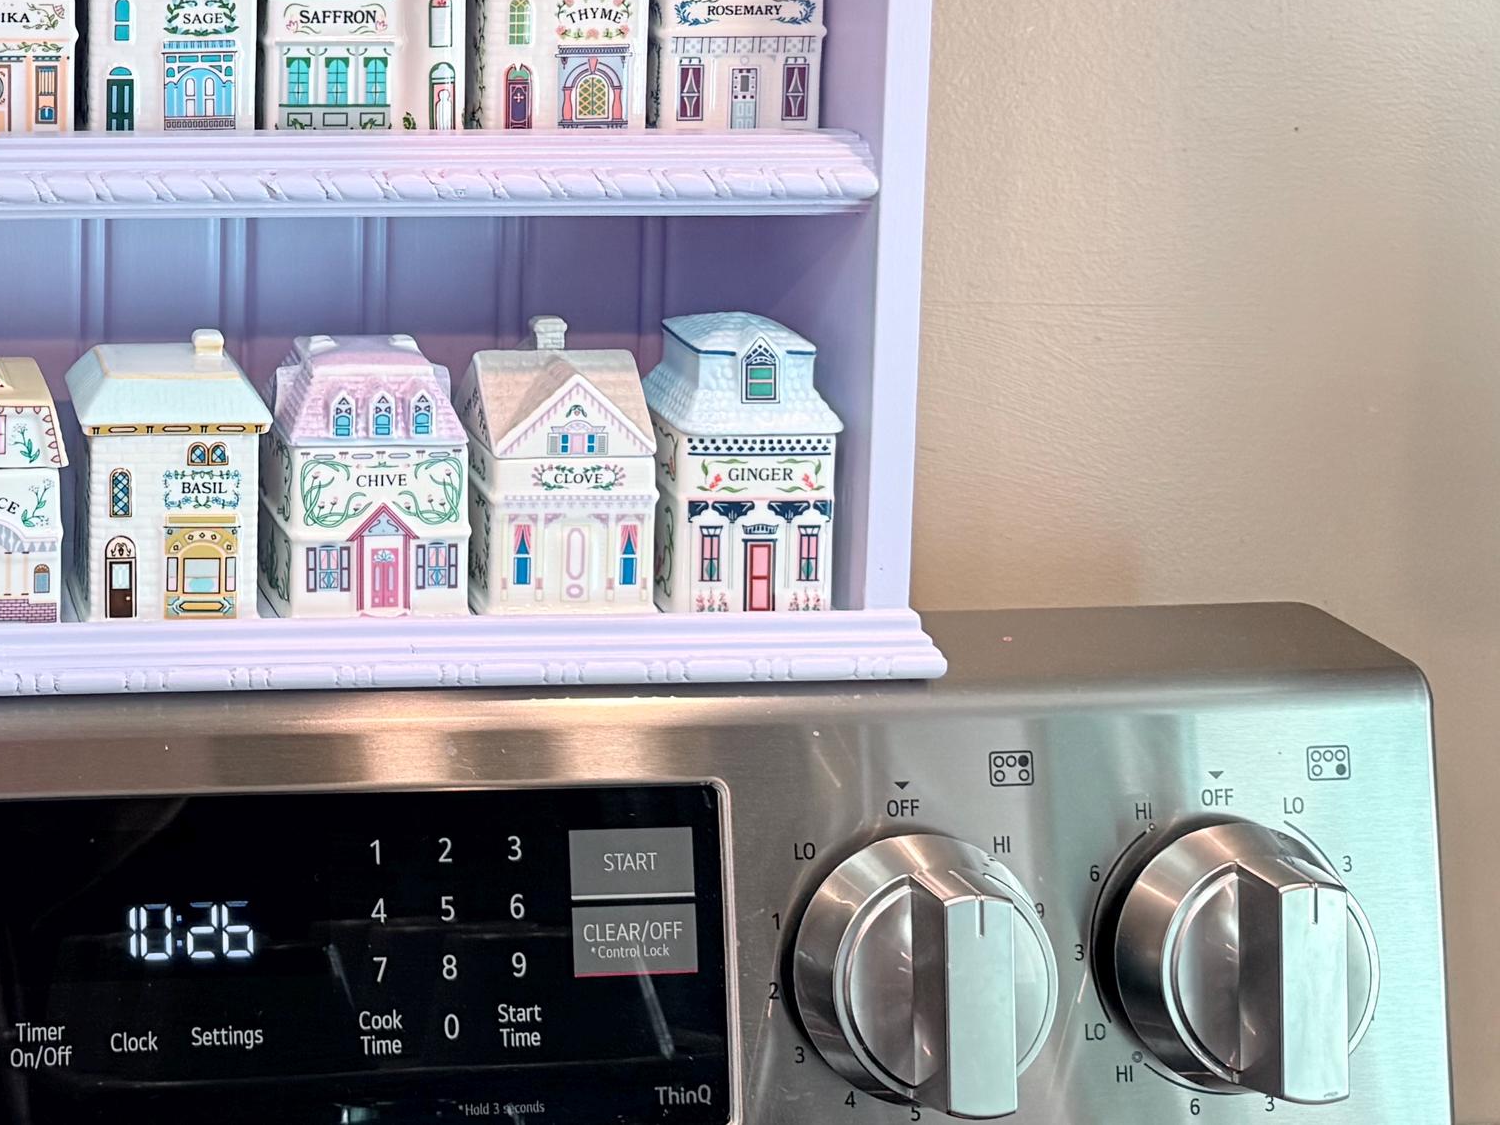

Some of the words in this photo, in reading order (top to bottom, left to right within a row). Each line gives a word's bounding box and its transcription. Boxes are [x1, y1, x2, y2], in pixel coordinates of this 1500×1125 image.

[182, 10, 224, 27] SAGE
[298, 6, 377, 27] SAFFRON
[565, 6, 623, 27] THYME
[706, 2, 782, 18] ROSEMARY
[356, 472, 408, 489] CHIVE
[553, 470, 604, 486] CLOVE
[727, 466, 794, 484] GINGER
[180, 480, 228, 496] BASIL
[1202, 789, 1233, 806] OFF
[1284, 797, 1304, 814] LO
[887, 799, 919, 817] OFF
[1136, 803, 1152, 820] HI
[370, 840, 380, 864] 1
[439, 838, 452, 862] 2
[508, 836, 521, 860] 3
[794, 843, 815, 860] LO
[994, 836, 1010, 853] HI
[604, 853, 657, 871] START
[1343, 856, 1352, 872] 3
[1090, 865, 1099, 882] 6
[371, 898, 387, 923] 4
[442, 896, 454, 921] 5
[511, 894, 524, 919] 6
[1035, 903, 1044, 919] 9
[129, 900, 254, 960] 10:26
[772, 913, 780, 930] 1
[584, 921, 682, 942] CLEAR/OFF
[644, 944, 669, 956] Lock
[1076, 942, 1086, 961] 3
[373, 957, 387, 982] 7
[443, 955, 457, 979] 8
[512, 952, 526, 977] 9
[769, 982, 781, 999] 2
[359, 1009, 402, 1030] Cook
[498, 1004, 541, 1022] Start
[16, 1023, 65, 1042] Timer
[445, 1014, 459, 1039] 0
[1085, 1023, 1105, 1040] LO
[111, 1031, 158, 1052] Clock
[192, 1026, 263, 1049] Settings
[360, 1035, 402, 1054] Time
[500, 1028, 540, 1047] Time
[11, 1046, 72, 1069] On/Off
[796, 1046, 805, 1063] 3
[1116, 1065, 1132, 1082] HI
[655, 1084, 711, 1105] ThinQ
[845, 1091, 856, 1108] 4
[1265, 1095, 1275, 1111] 3
[494, 1103, 499, 1114] 3
[503, 1100, 545, 1114] seconds
[911, 1107, 920, 1121] 5
[1191, 1098, 1200, 1115] 6
